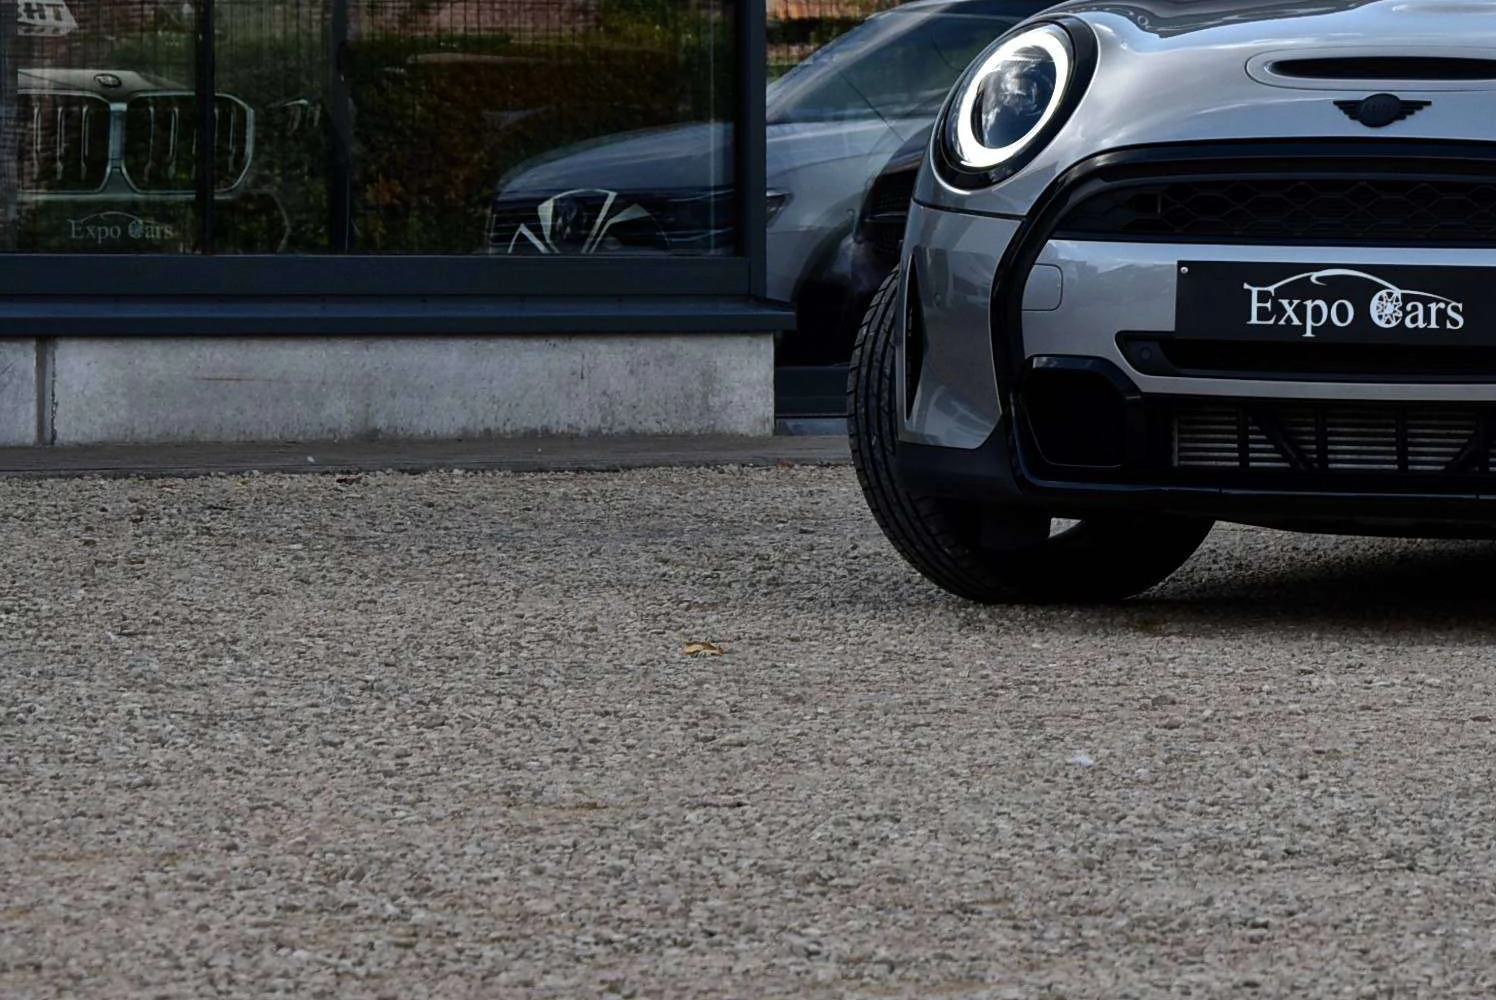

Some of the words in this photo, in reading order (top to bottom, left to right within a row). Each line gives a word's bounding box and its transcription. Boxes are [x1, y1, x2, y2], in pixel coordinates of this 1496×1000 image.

[70, 220, 121, 244] Expo
[128, 220, 173, 239] Cars
[1245, 287, 1354, 337] Expo
[1370, 289, 1464, 329] Cars
